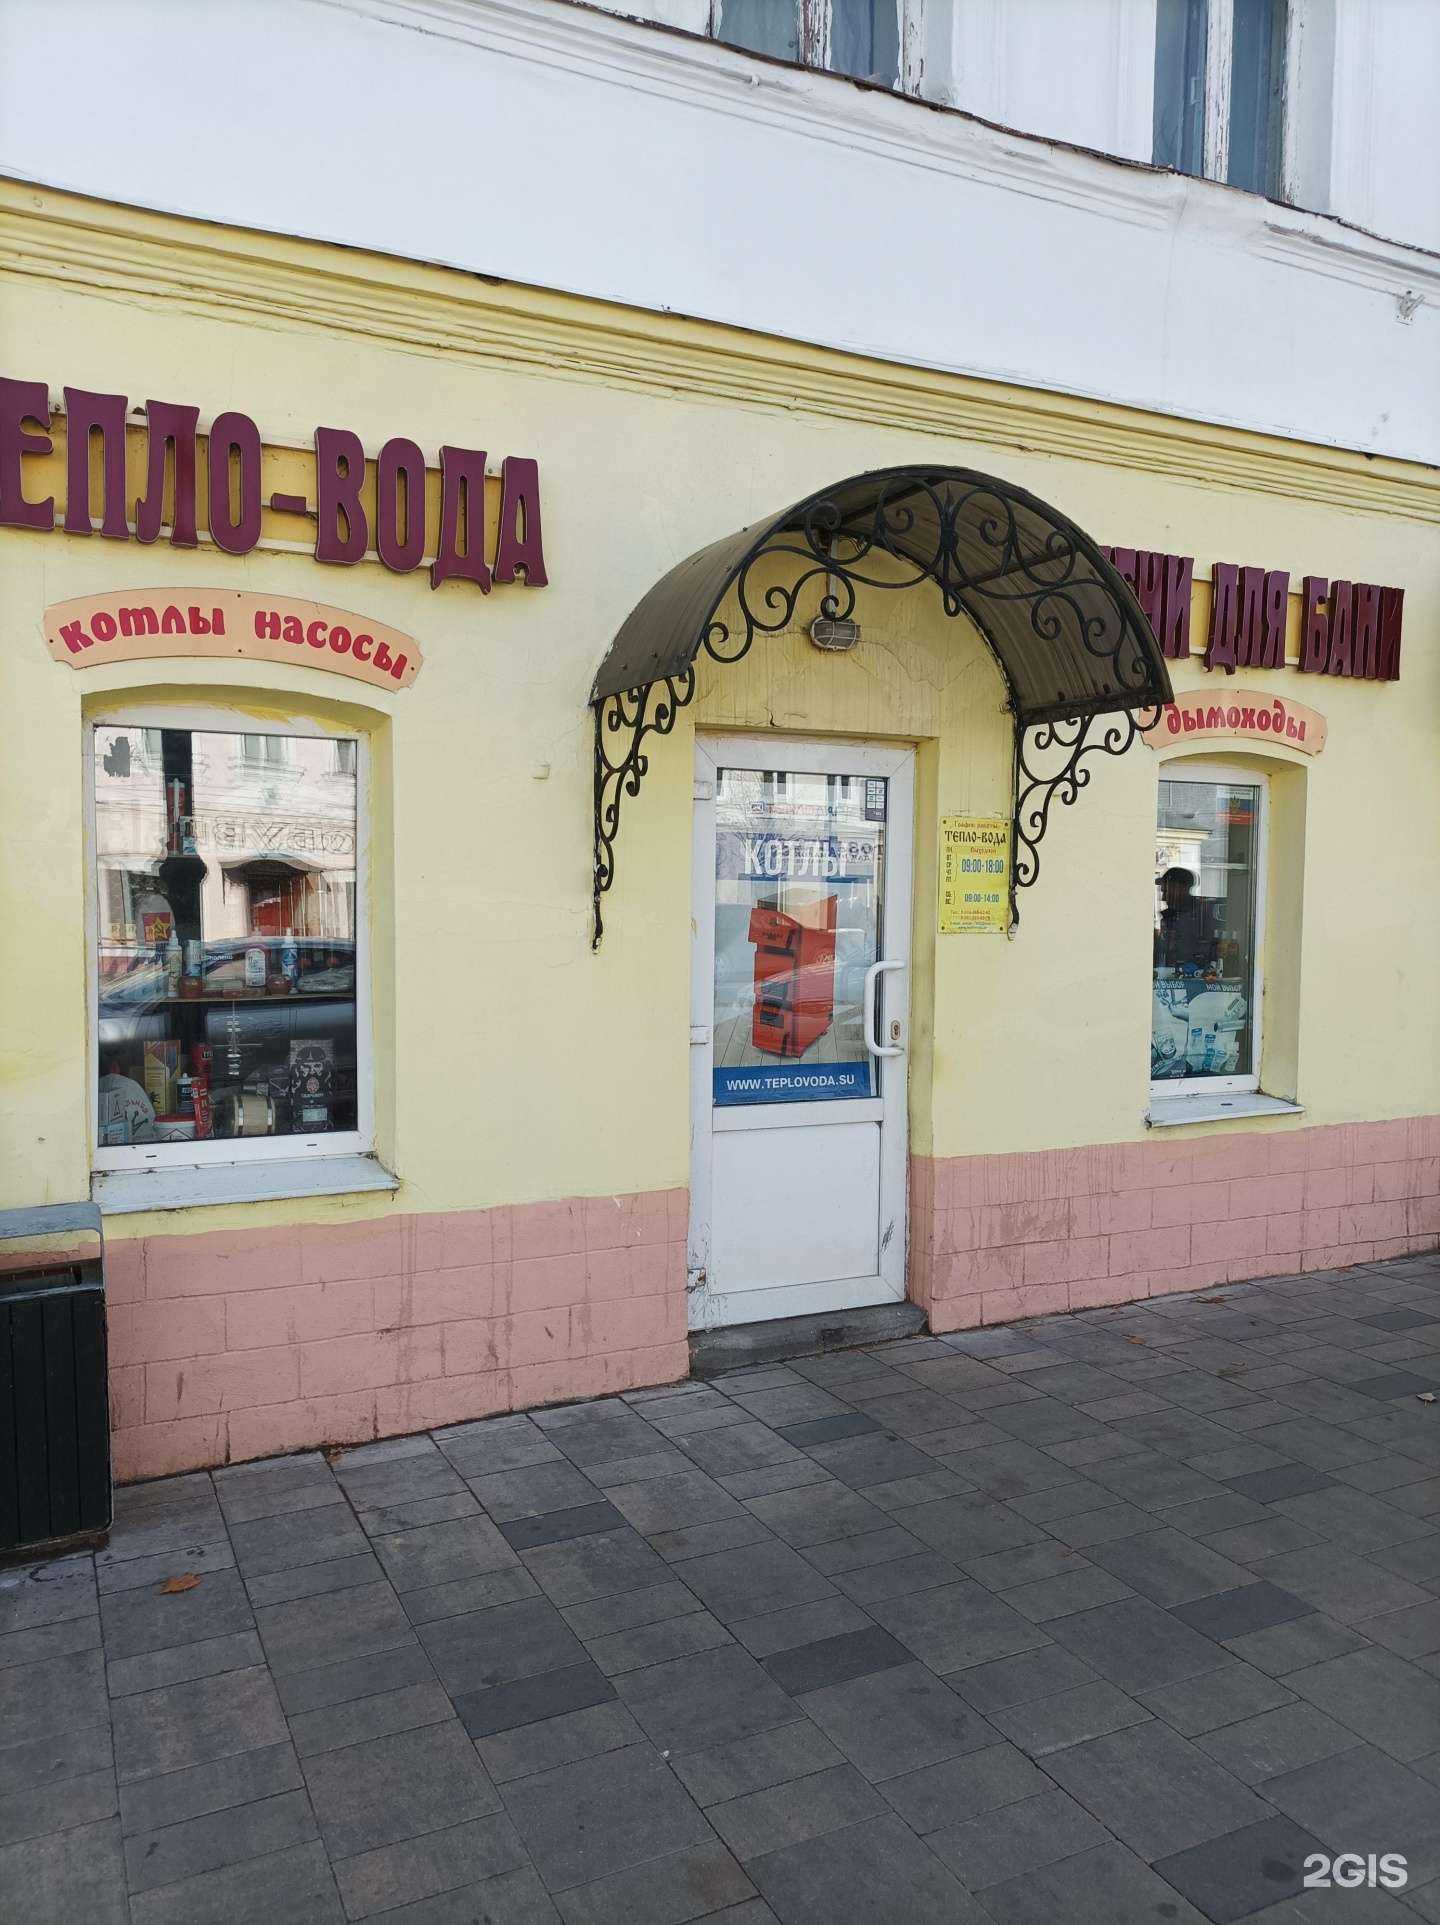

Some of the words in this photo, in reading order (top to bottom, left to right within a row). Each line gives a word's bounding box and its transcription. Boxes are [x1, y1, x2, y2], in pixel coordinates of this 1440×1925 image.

[1203, 562, 1290, 675] ДЛЯ
[1299, 575, 1405, 681] БАНИ
[744, 838, 847, 878] КОТЛЫ
[727, 1074, 855, 1091] WWW.TEPLOVODA.SU
